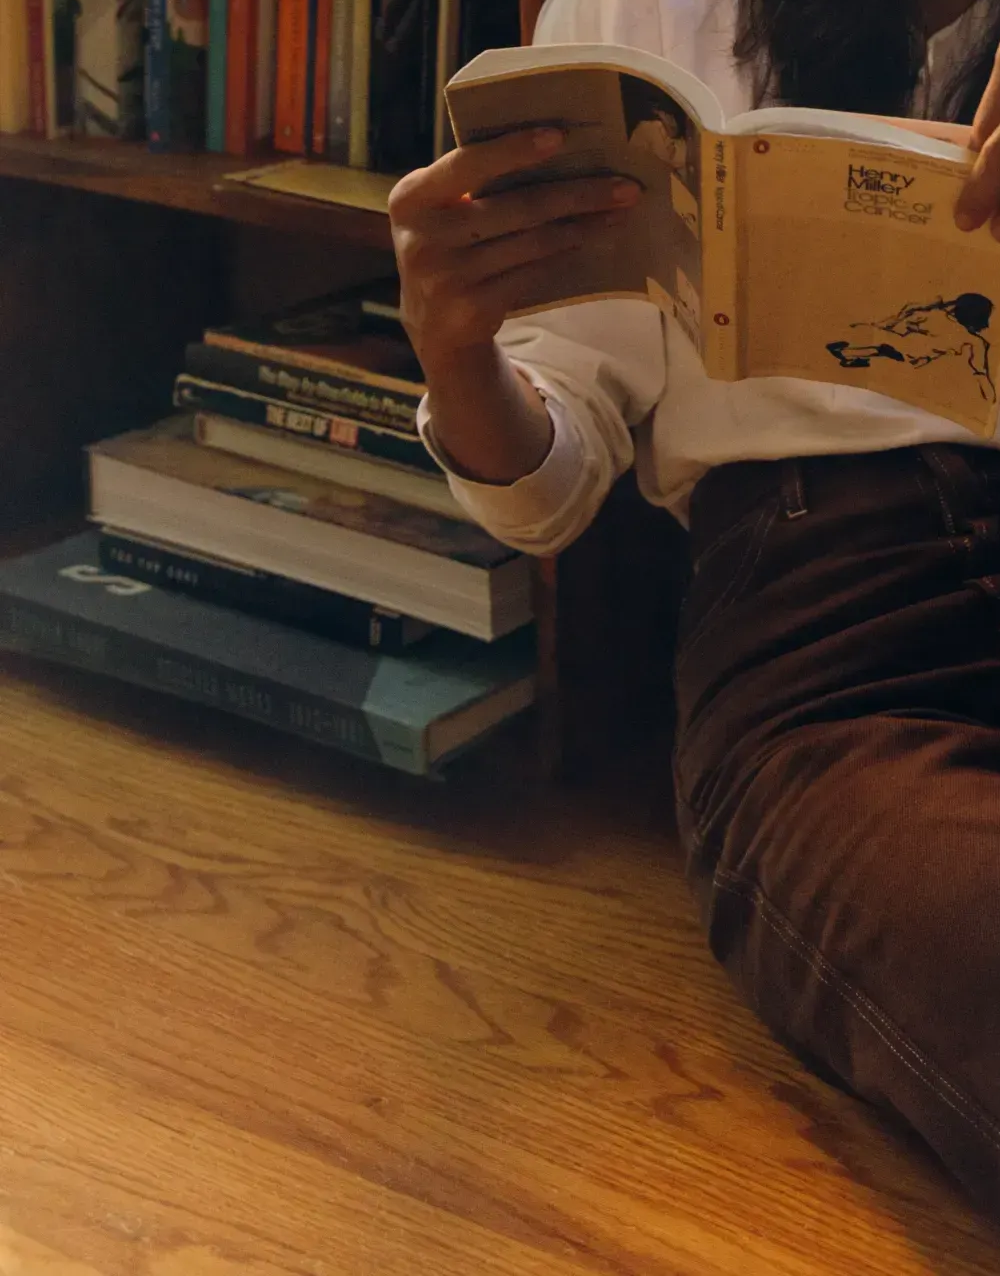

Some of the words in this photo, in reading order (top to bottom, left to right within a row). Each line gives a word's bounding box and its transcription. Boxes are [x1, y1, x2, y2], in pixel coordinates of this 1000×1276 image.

[847, 176, 903, 195] Miller
[848, 164, 915, 188] Henry
[844, 201, 933, 225] Cancer
[846, 189, 908, 208] Tropic
[912, 202, 933, 214] of
